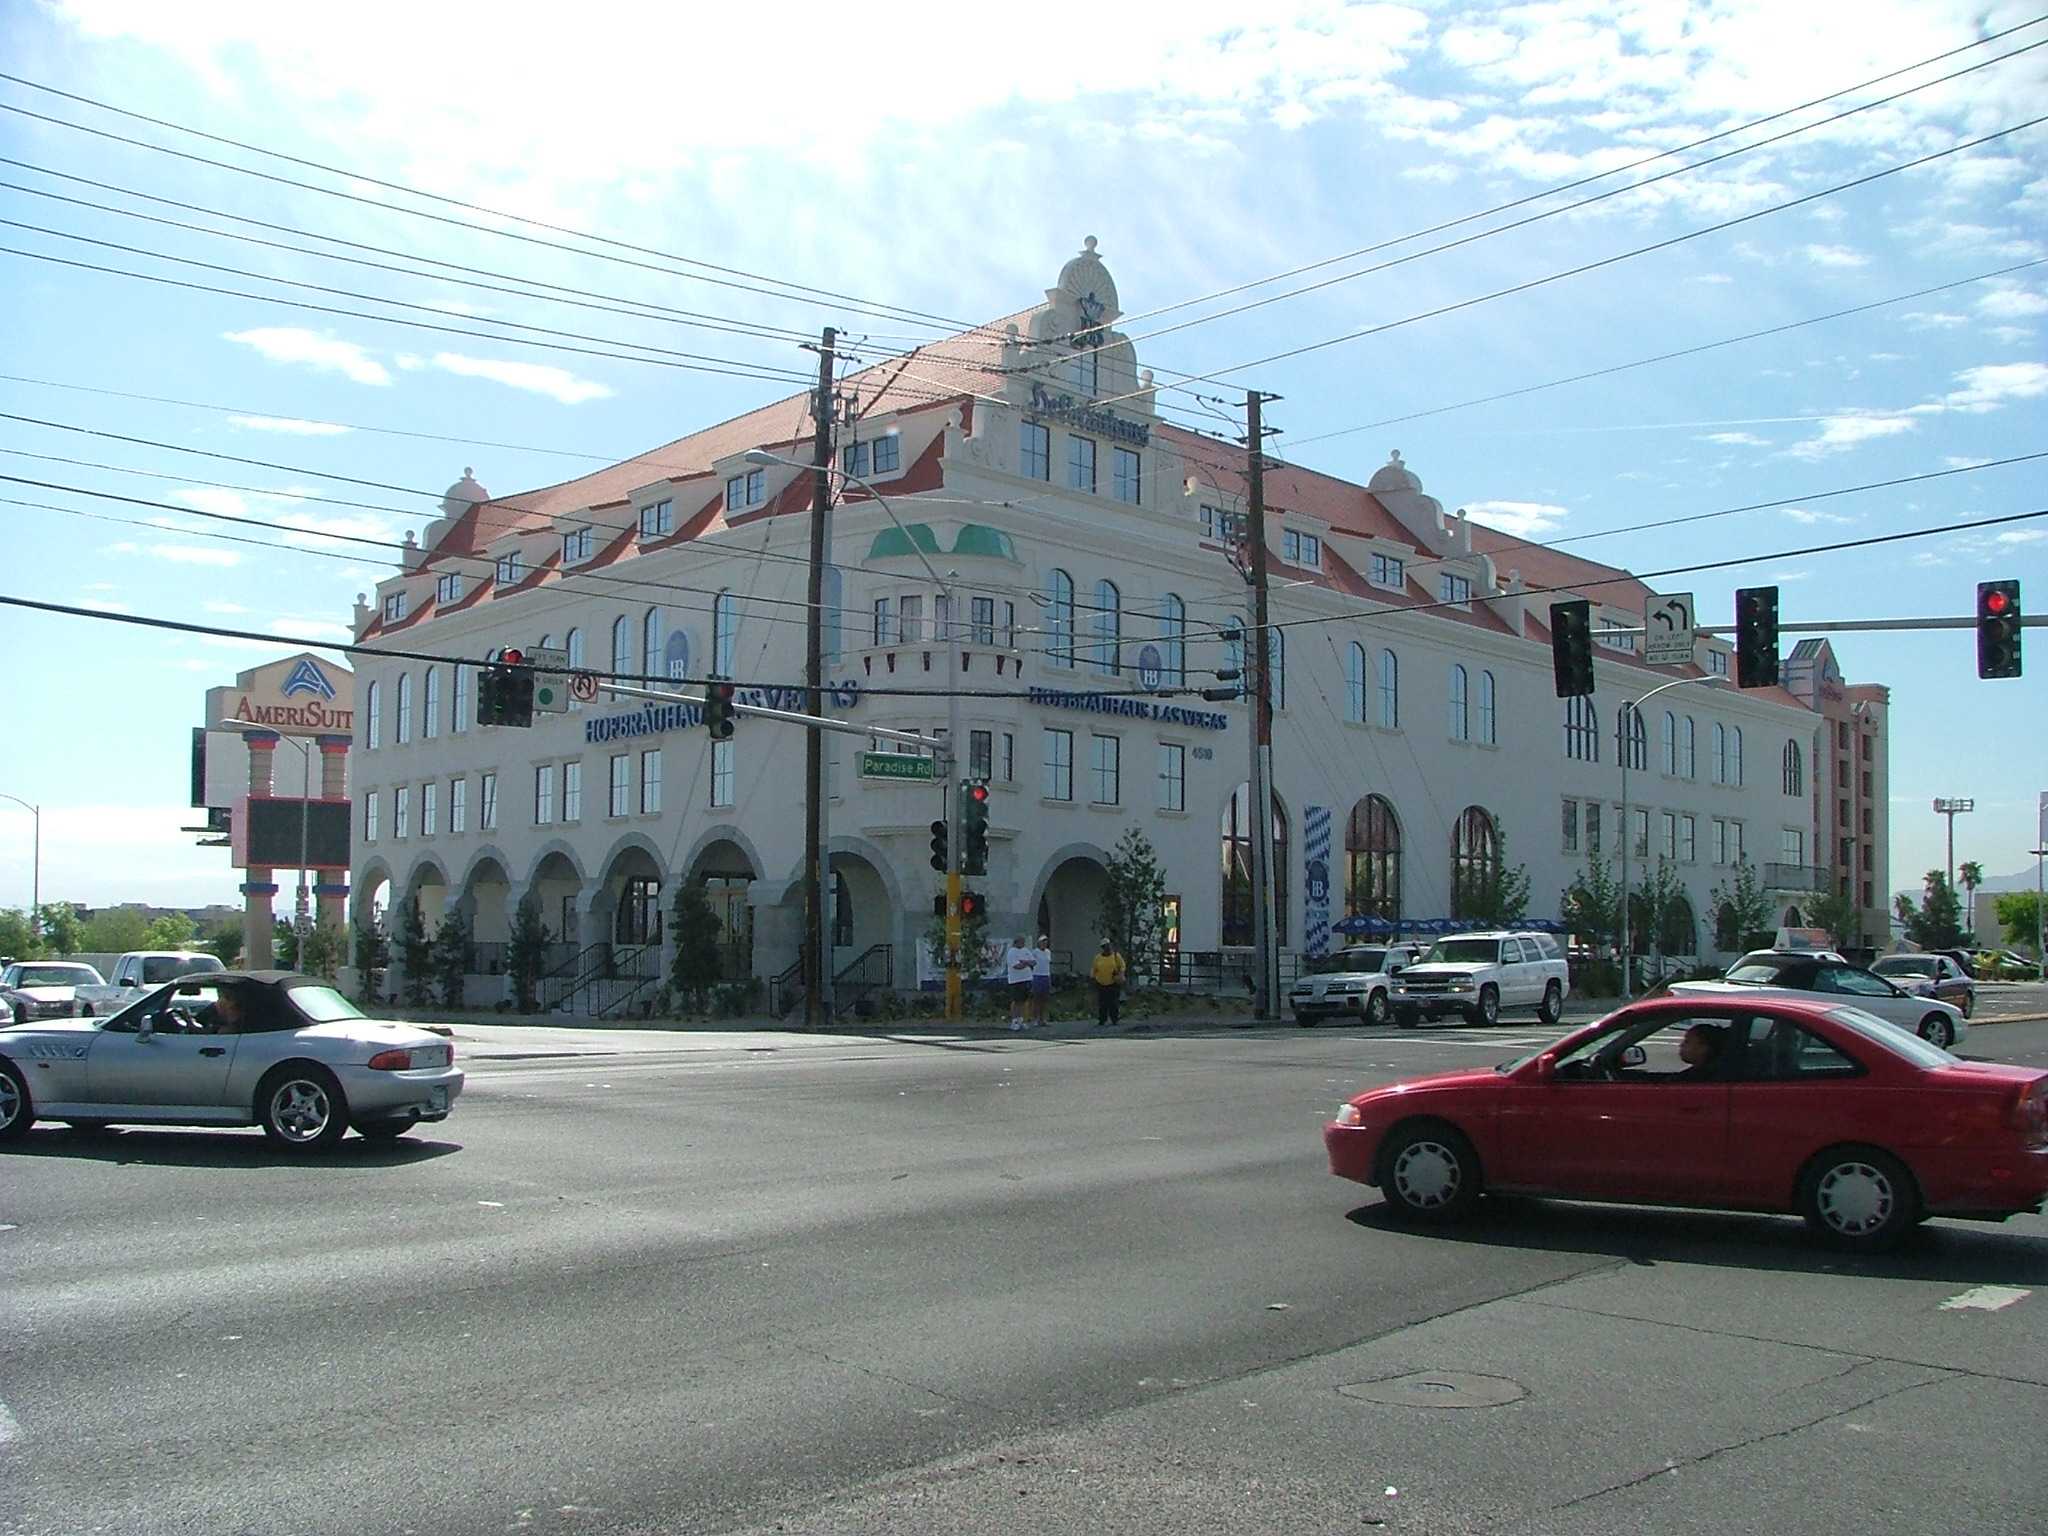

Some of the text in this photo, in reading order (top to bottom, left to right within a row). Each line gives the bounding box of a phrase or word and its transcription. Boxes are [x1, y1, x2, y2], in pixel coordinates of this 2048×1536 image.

[236, 695, 354, 730] AMERISUIT
[586, 702, 704, 742] HOFBRÄUHAU
[864, 759, 931, 776] Paradise Rd
